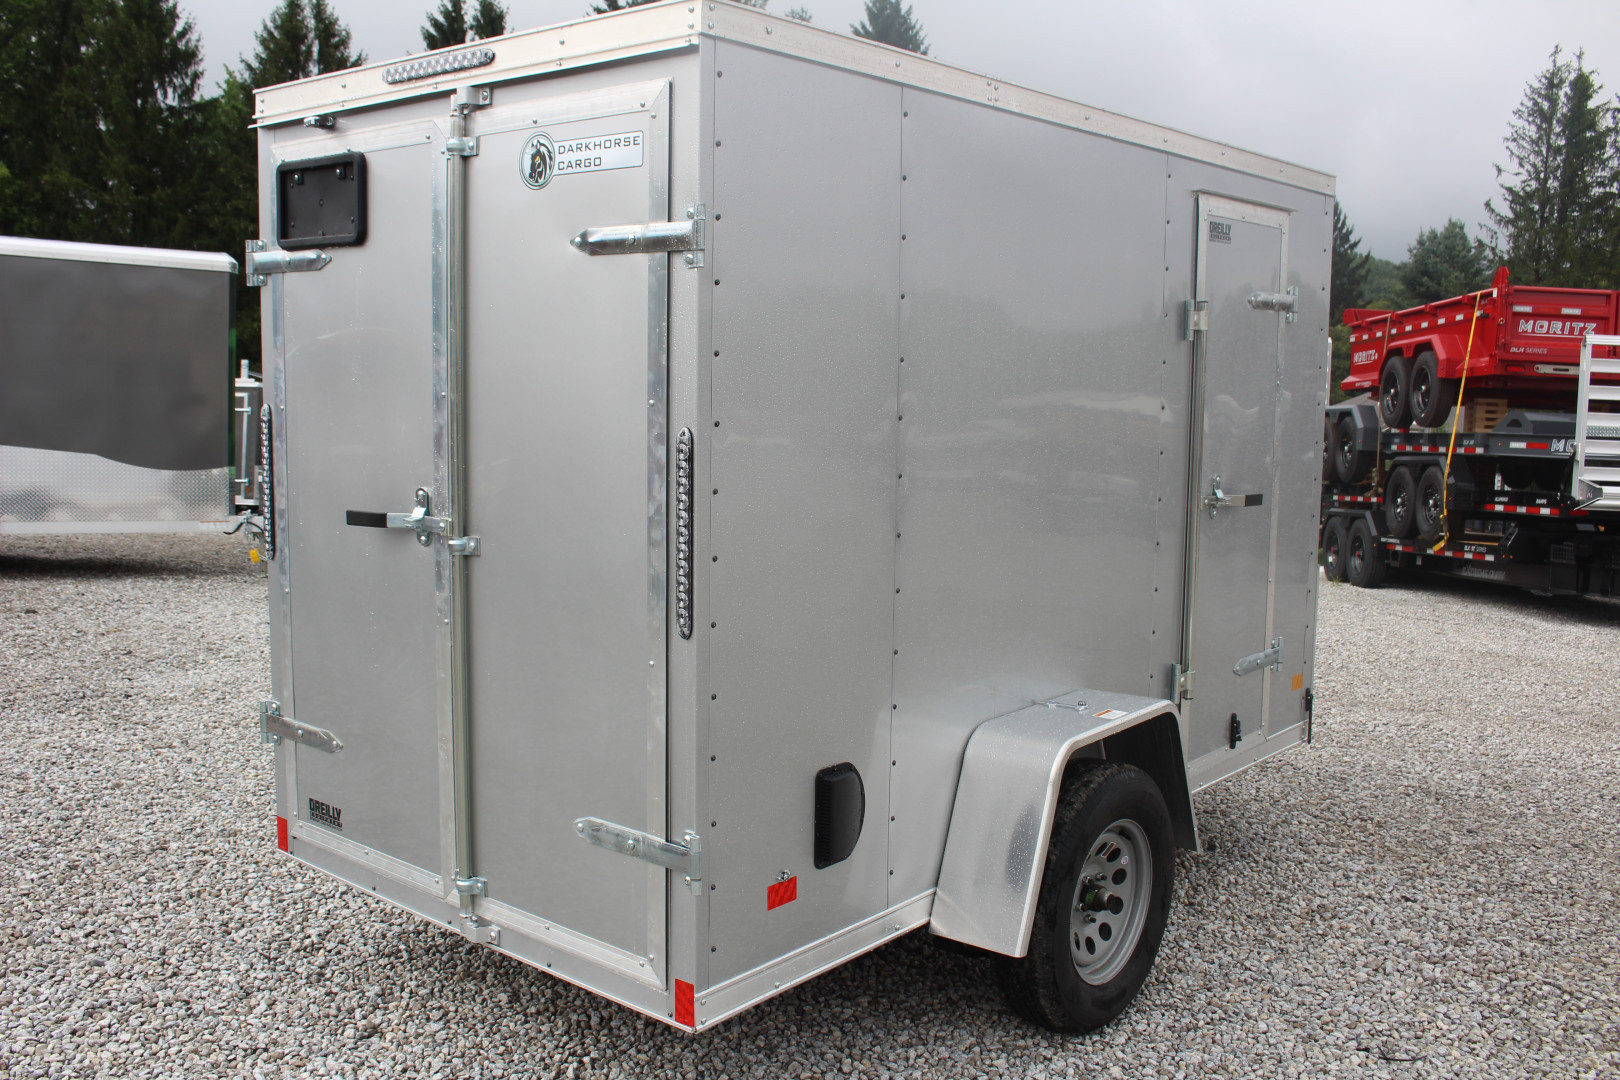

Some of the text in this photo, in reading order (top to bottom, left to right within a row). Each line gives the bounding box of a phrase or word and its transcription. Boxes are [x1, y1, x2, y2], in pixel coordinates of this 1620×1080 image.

[558, 136, 641, 155] DARKHORSE
[558, 157, 602, 171] CARGO
[1518, 319, 1597, 335] MORITZ
[309, 797, 342, 821] OREILLY
